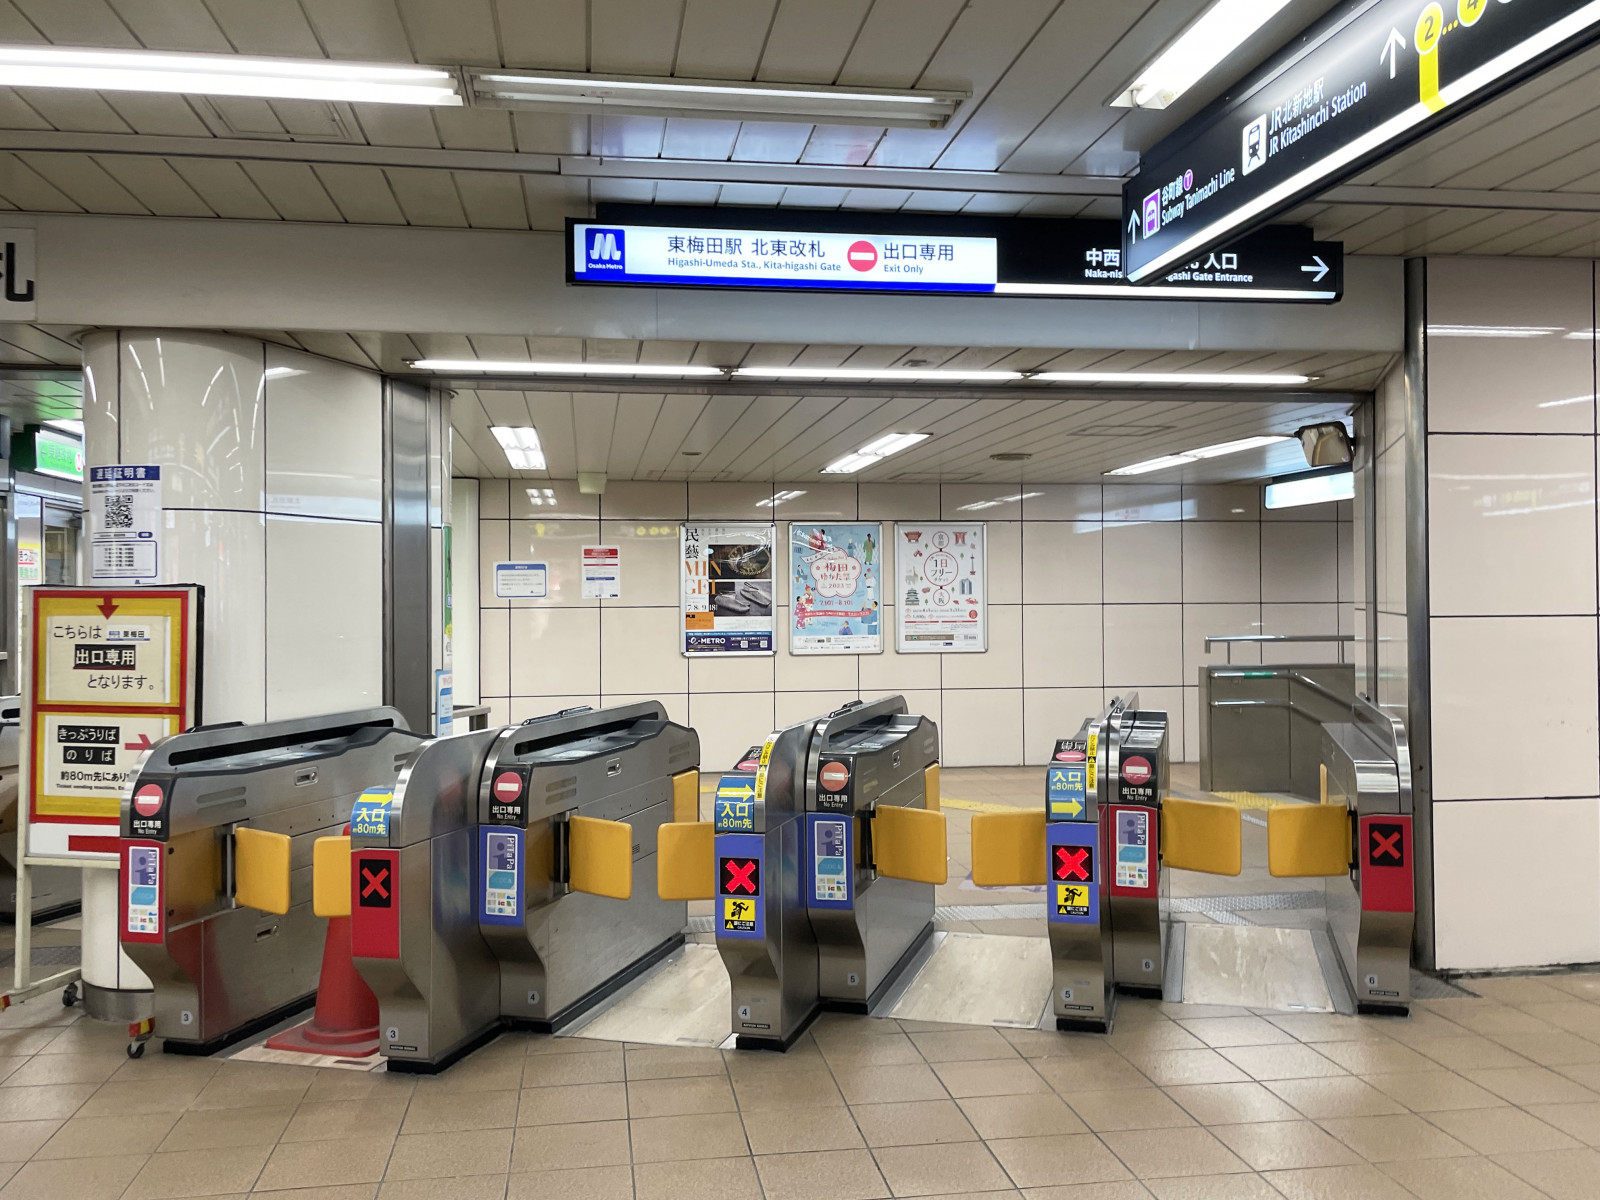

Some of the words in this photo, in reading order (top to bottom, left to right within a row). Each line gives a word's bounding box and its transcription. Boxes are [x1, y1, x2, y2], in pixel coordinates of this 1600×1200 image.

[1424, 15, 1434, 42] 2
[1269, 76, 1324, 136] JR北新地駅
[1269, 135, 1279, 158] JR
[1280, 101, 1329, 150] Kitashinchi
[1331, 81, 1367, 118] Station
[1162, 200, 1185, 226] Subway
[1185, 175, 1218, 211] Tanimachi
[1219, 167, 1235, 189] Line
[667, 235, 742, 255] 東梅田駅
[751, 238, 825, 258] 北東改札
[884, 242, 954, 262] 出口専用
[667, 258, 738, 269] Higashi-Umeda
[741, 260, 762, 270] Sta.,
[763, 261, 818, 272] Kita-higashi
[820, 262, 842, 271] Gate
[1086, 248, 1121, 267] 中西
[1204, 253, 1238, 270] 入口
[884, 264, 901, 273] Exit
[903, 264, 924, 274] Only
[1167, 271, 1191, 282] gashi
[1193, 273, 1214, 281] Gate
[1215, 273, 1253, 282] Entrance
[685, 561, 722, 576] MIN
[931, 568, 953, 577] フリー
[54, 625, 102, 639] こちらは
[75, 648, 135, 666] 出口専用
[87, 674, 154, 690] となります。
[58, 728, 117, 741] きっぷうりば
[66, 749, 113, 762] のりば
[1053, 771, 1081, 782] 入口
[819, 794, 848, 803] 出口専用
[1122, 787, 1152, 796] 出口専用
[356, 807, 385, 822] 入口
[492, 805, 521, 814] 出口専用
[721, 802, 748, 817] 入口
[1137, 815, 1146, 845] PiTaPa
[834, 825, 843, 856] PiTaPa
[506, 837, 515, 869] PiTaPa
[1144, 961, 1150, 969] 6
[1369, 977, 1375, 985] 6
[530, 993, 536, 1001] 4
[1065, 990, 1071, 998] 5
[183, 1013, 189, 1021] 3
[742, 1008, 747, 1016] 4
[390, 1030, 396, 1038] 3
